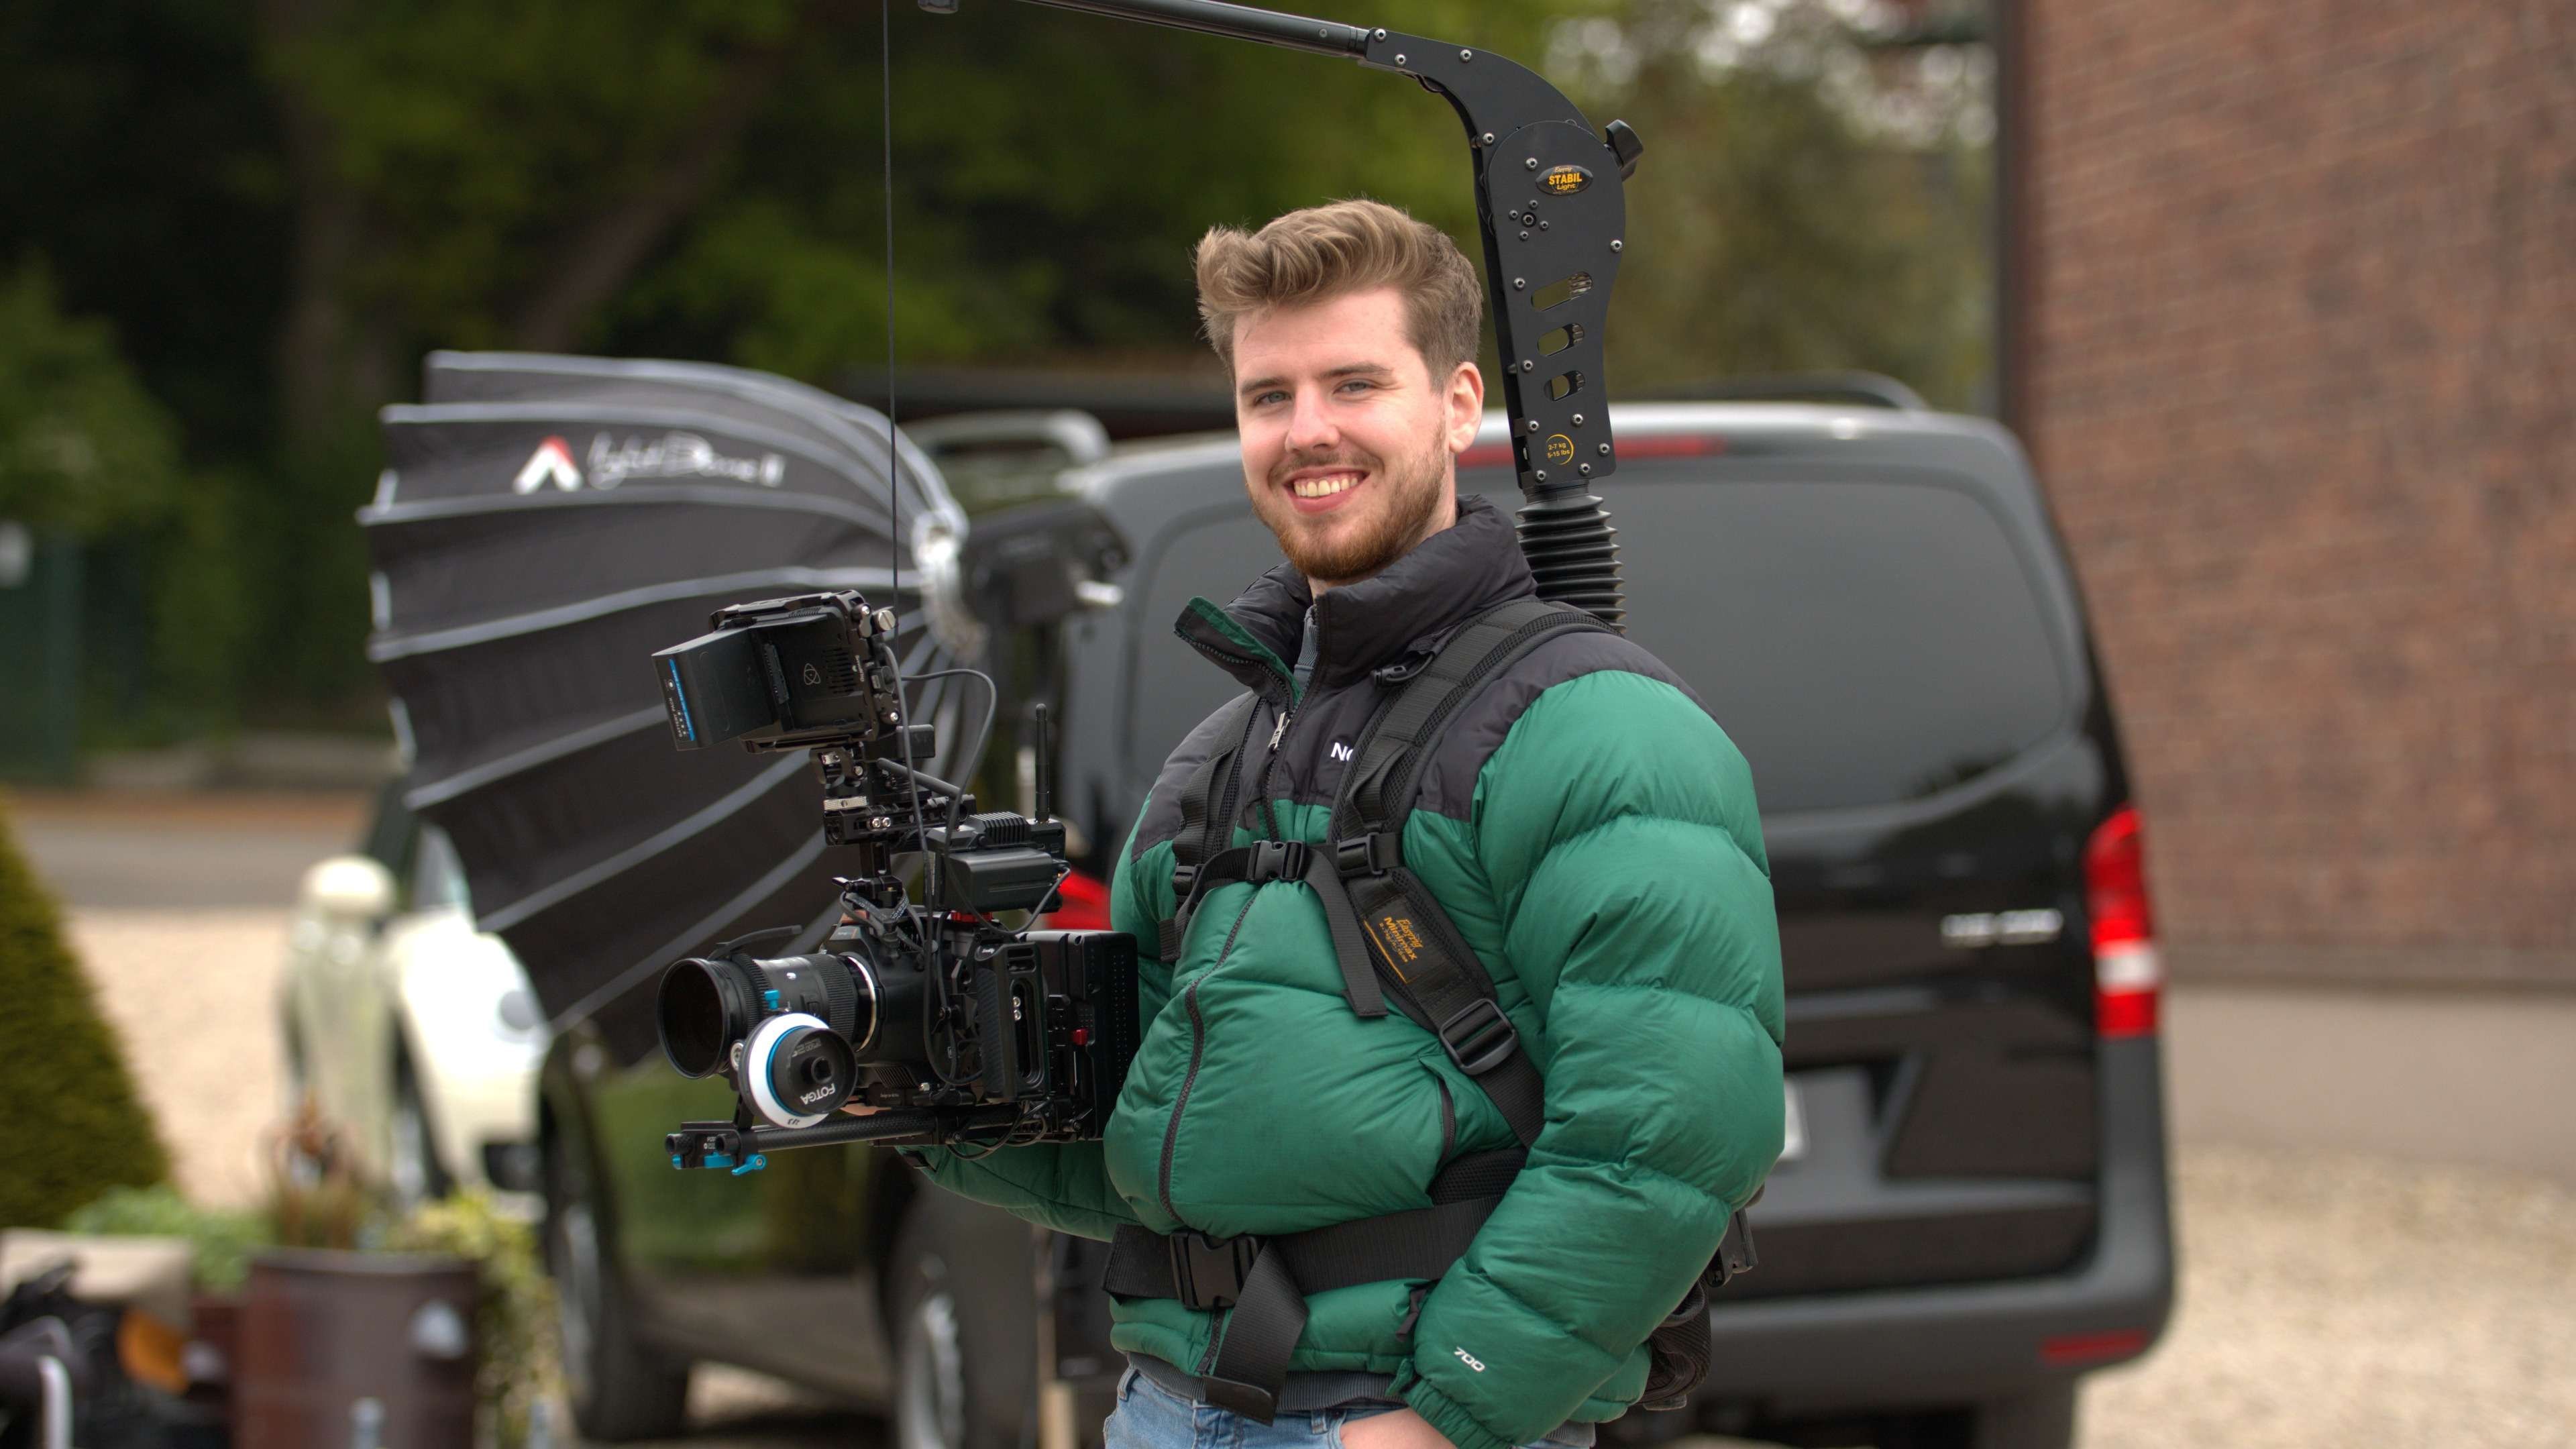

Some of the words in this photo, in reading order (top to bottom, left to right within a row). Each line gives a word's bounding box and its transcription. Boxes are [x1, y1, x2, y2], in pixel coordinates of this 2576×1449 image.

[1548, 172, 1582, 185] STABIL
[1384, 917, 1417, 960] Minimax
[800, 1083, 835, 1105] FOTGA
[1454, 1346, 1485, 1373] 700
